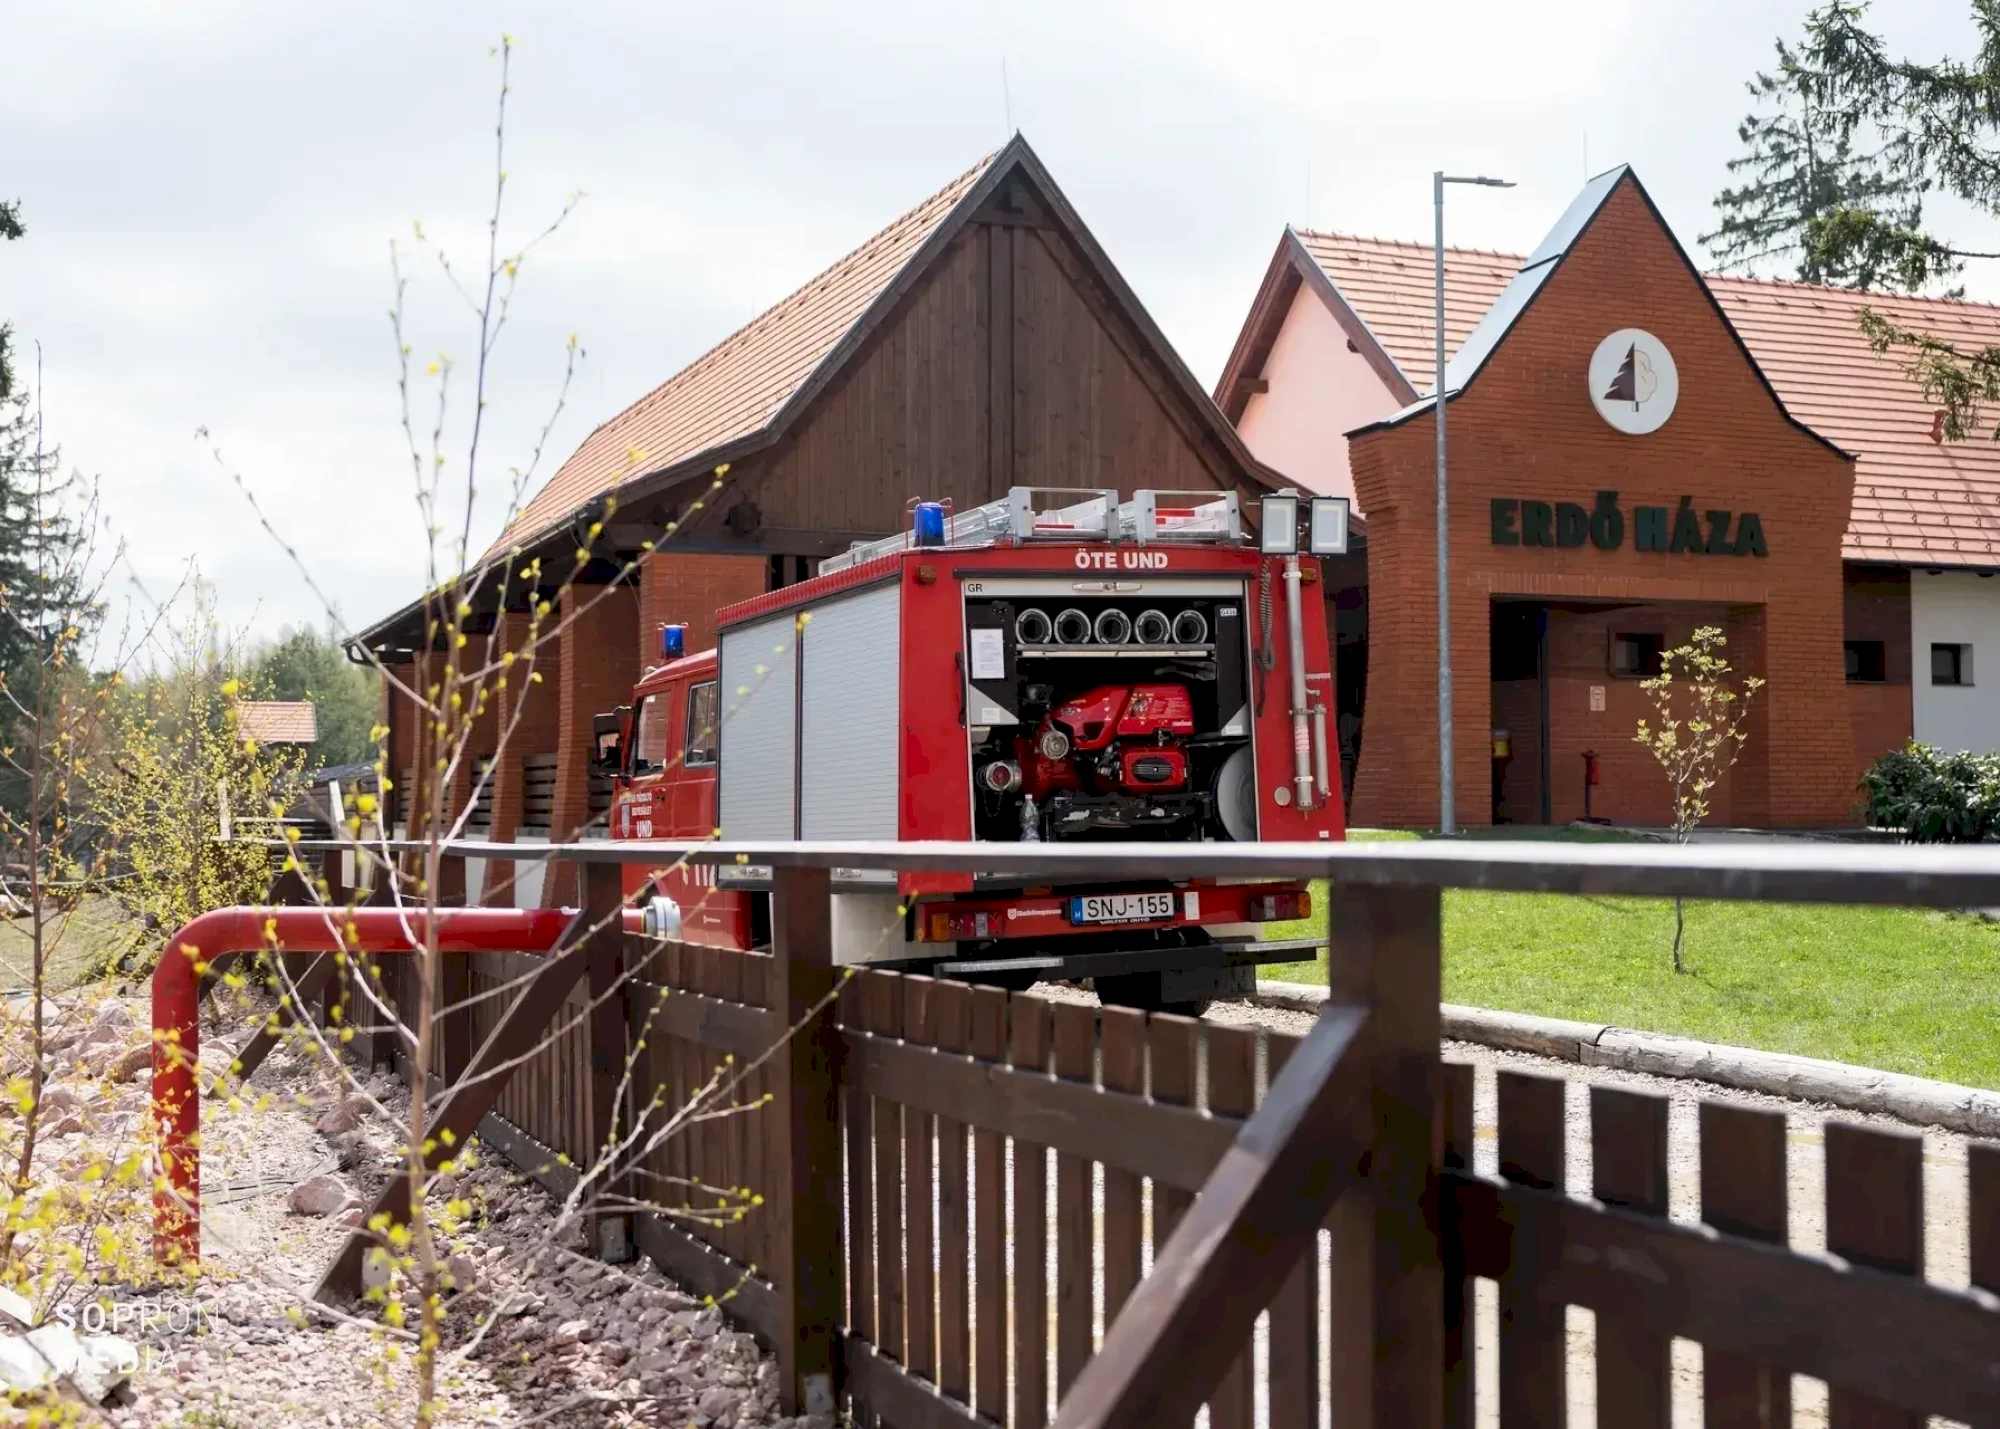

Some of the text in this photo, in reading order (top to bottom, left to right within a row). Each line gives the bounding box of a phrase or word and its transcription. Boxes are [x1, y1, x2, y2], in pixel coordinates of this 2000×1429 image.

[1491, 490, 1768, 557] ERDŐ HÁZA
[1075, 548, 1168, 569] ÖTE UND
[967, 583, 983, 593] GR
[636, 820, 652, 838] UND
[1087, 895, 1169, 918] SNJ-155
